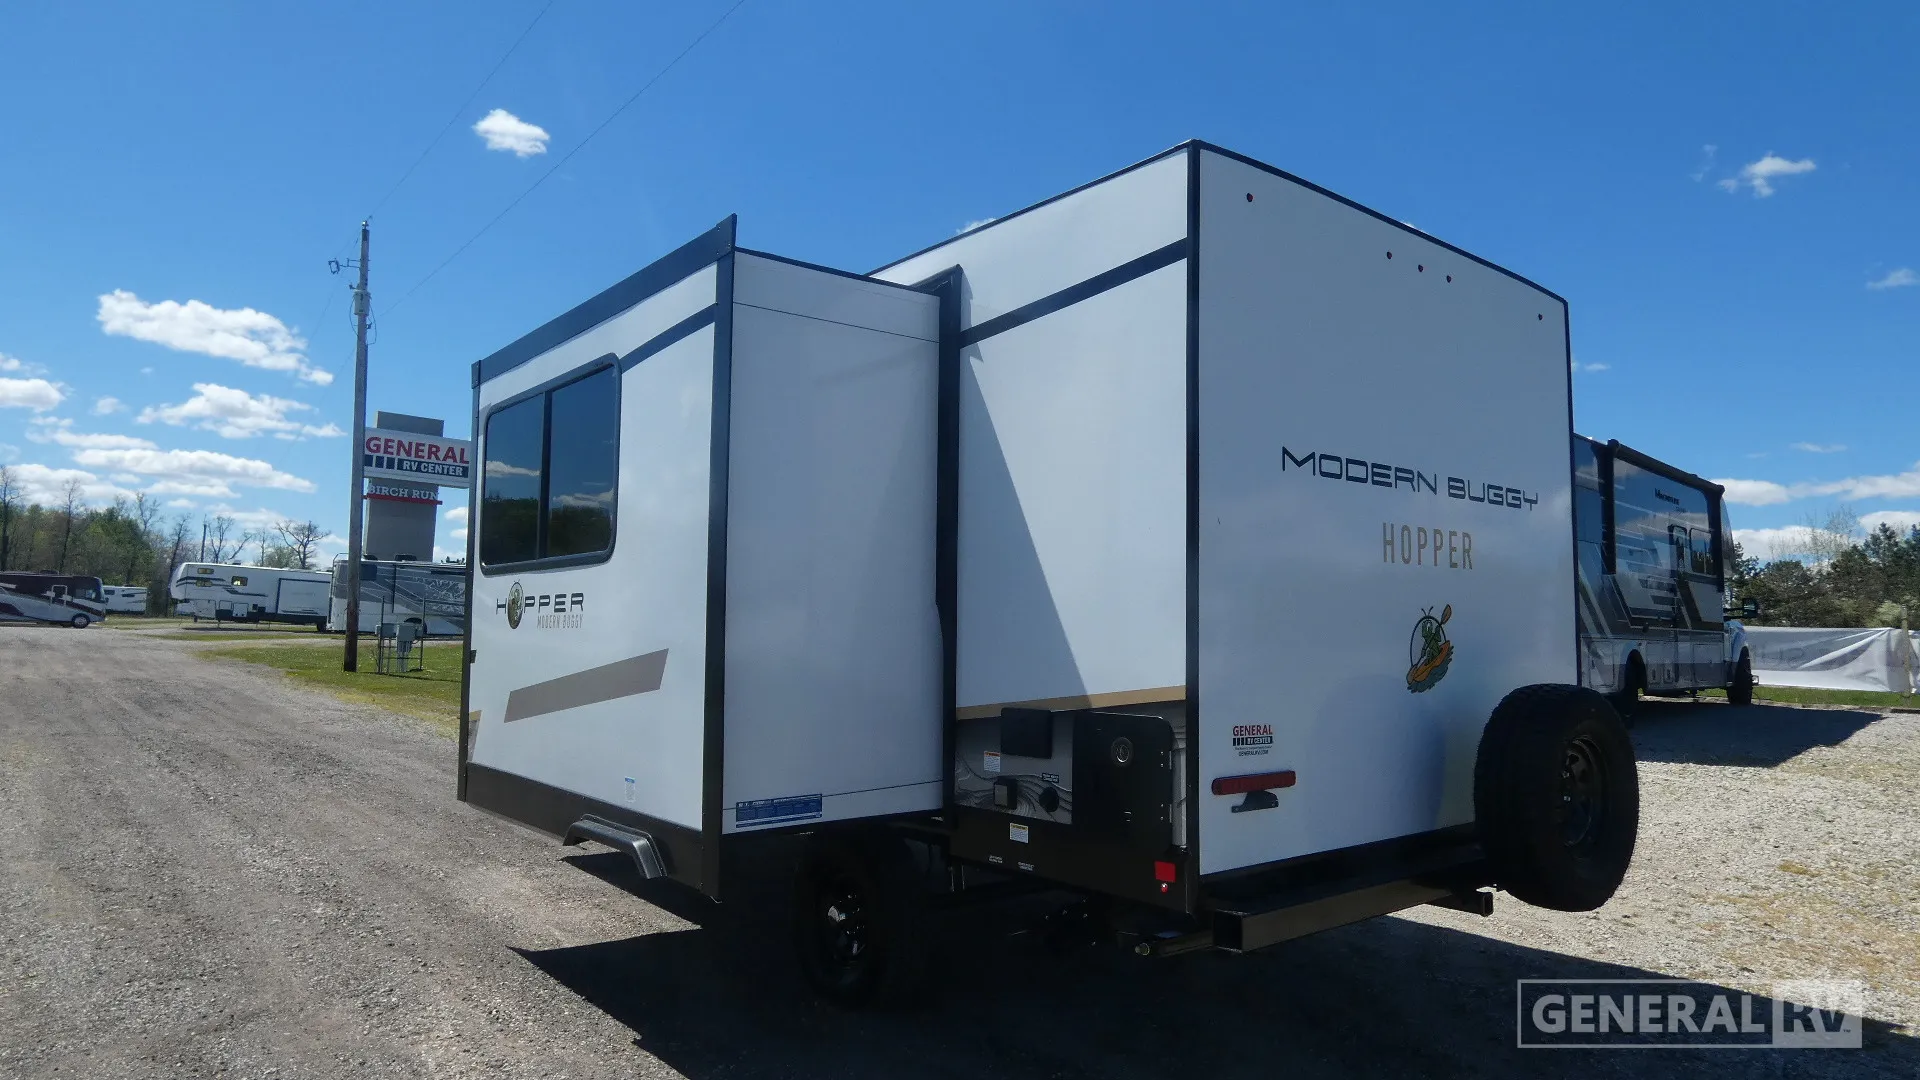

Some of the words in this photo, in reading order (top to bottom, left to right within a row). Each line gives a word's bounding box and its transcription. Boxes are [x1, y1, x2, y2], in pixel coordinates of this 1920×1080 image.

[365, 436, 470, 465] GENERAL
[402, 460, 417, 471] RV
[421, 461, 463, 476] CENTER
[1282, 446, 1437, 495] MODERN
[1447, 476, 1538, 511] BUGGY
[367, 484, 409, 498] BIRCH
[412, 489, 439, 501] RUN
[1382, 522, 1473, 570] HOPPER
[1232, 725, 1272, 736] GENERAL
